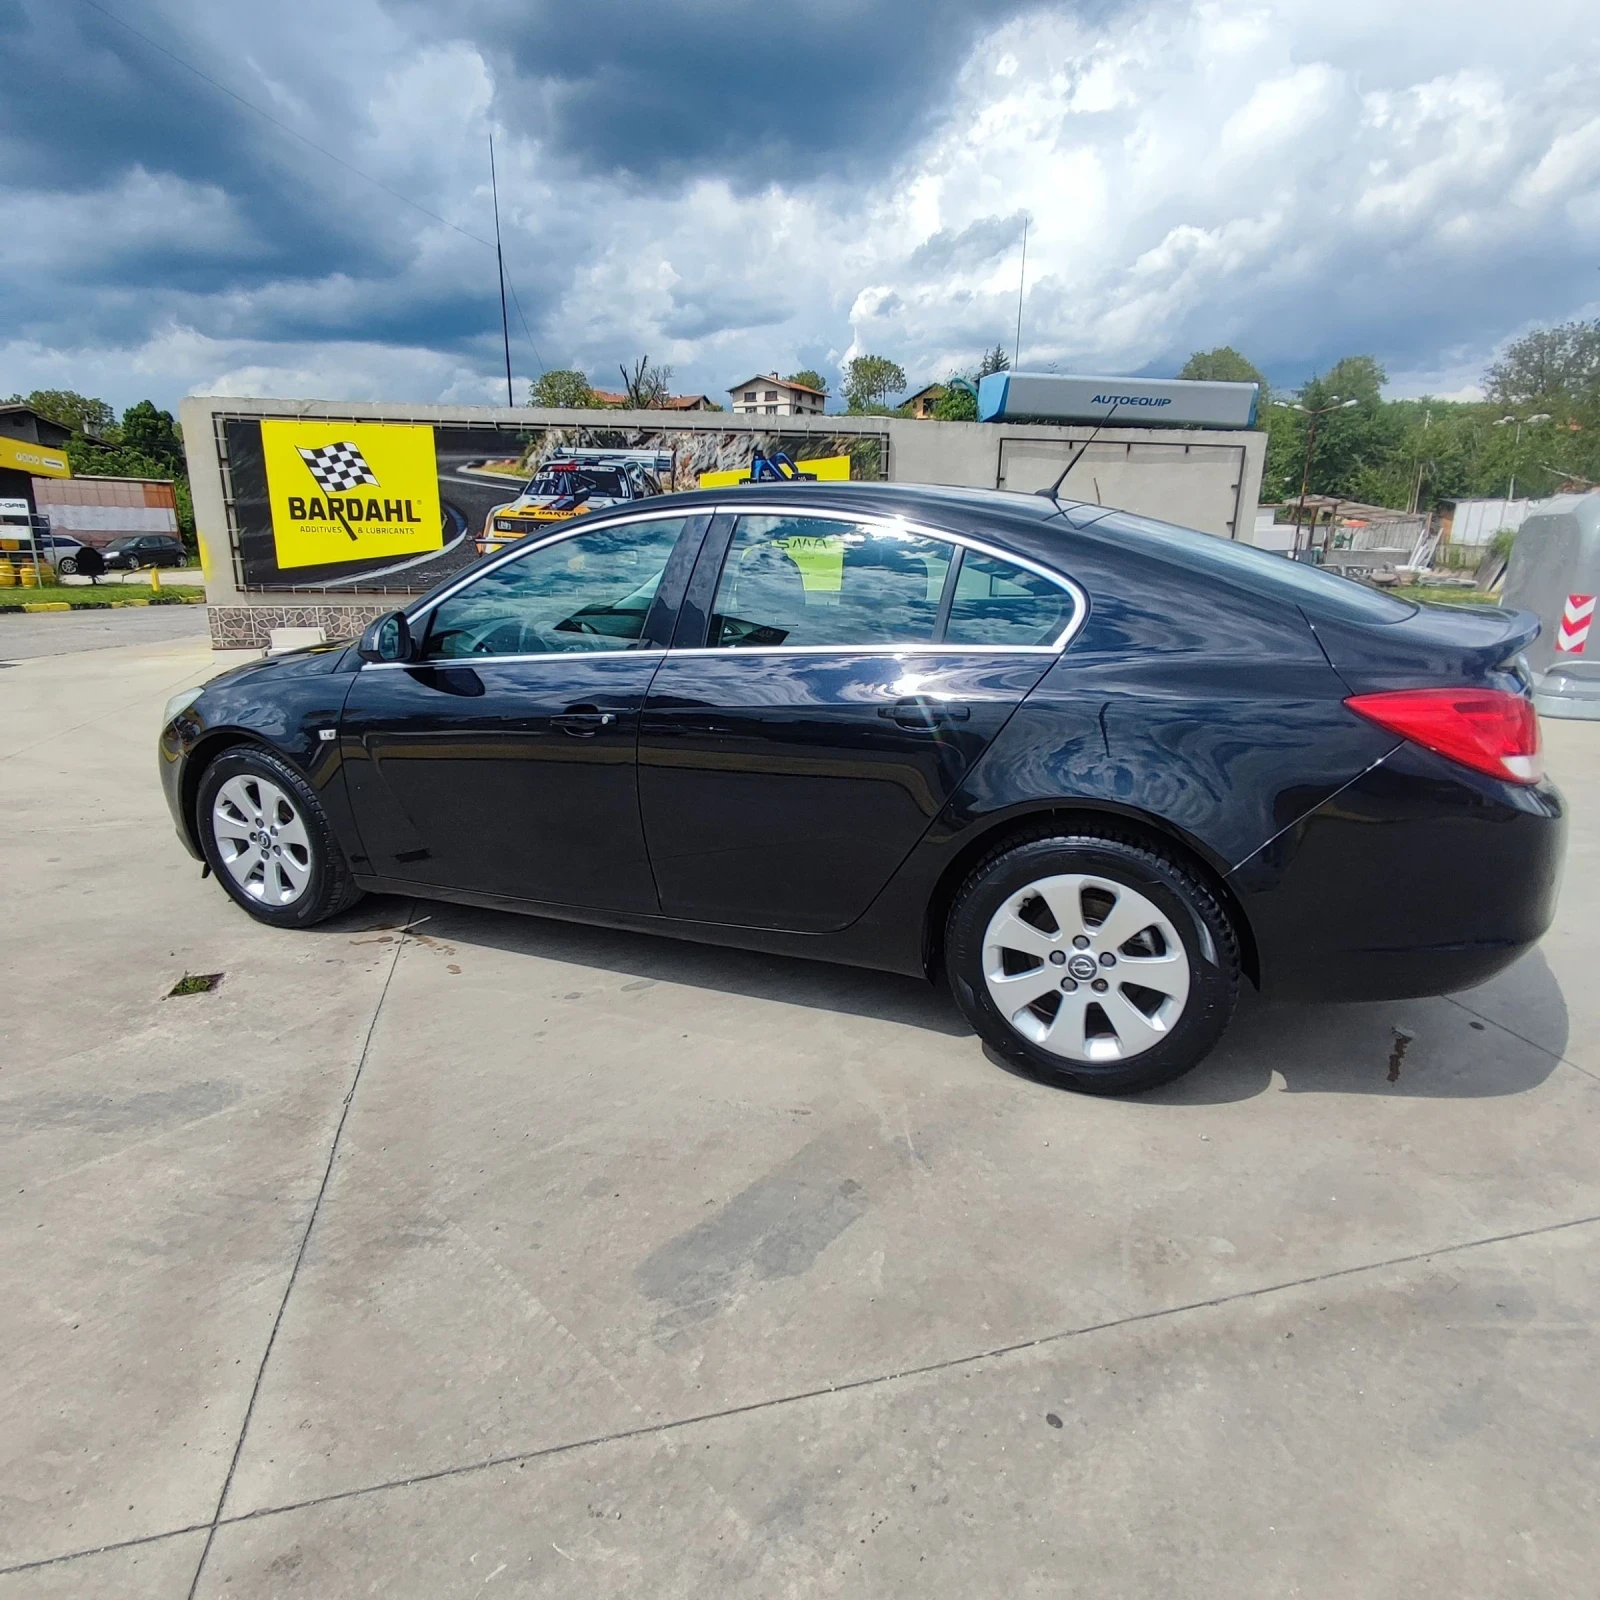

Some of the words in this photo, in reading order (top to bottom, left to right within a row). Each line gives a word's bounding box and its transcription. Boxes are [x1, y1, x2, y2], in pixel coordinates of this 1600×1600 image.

[1090, 394, 1172, 407] AUTOEQUIP
[287, 496, 422, 541] BARDAHL
[299, 525, 343, 534] ADDITIVES
[357, 526, 364, 534] &
[365, 527, 415, 535] LUBRICANTS
